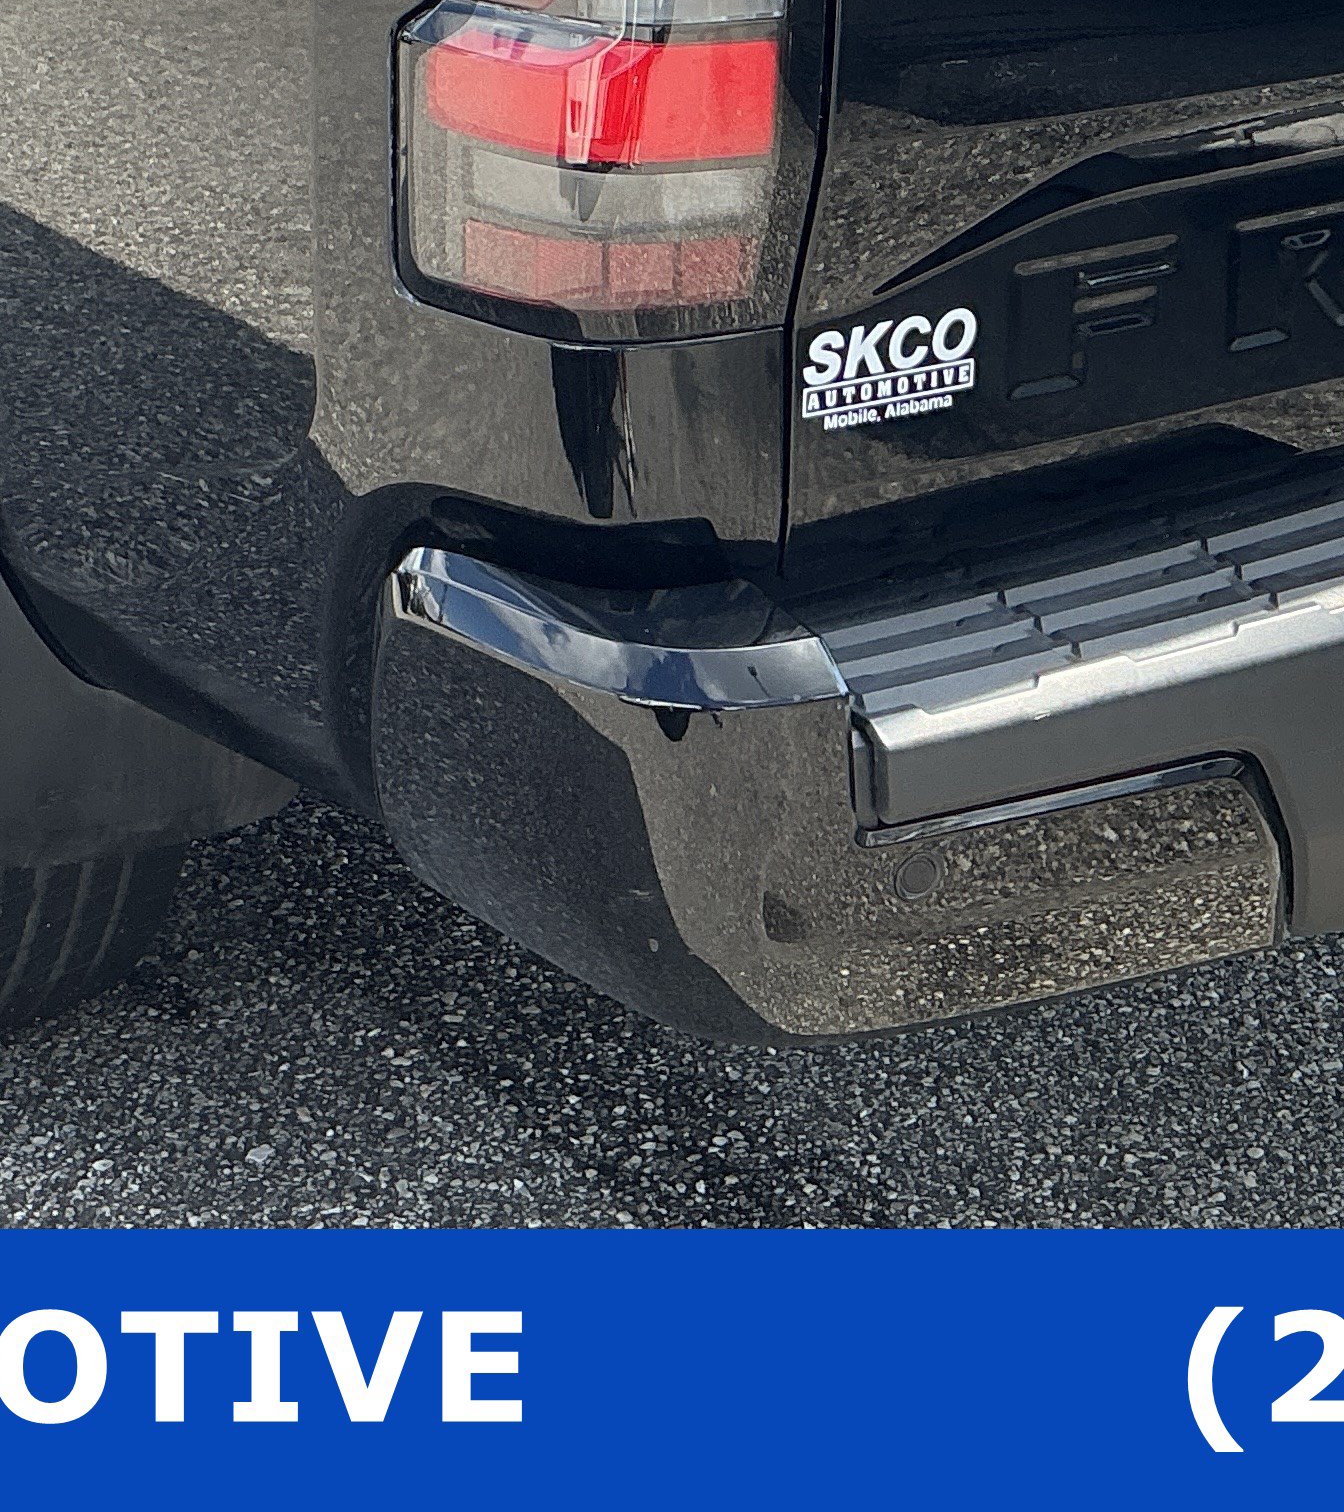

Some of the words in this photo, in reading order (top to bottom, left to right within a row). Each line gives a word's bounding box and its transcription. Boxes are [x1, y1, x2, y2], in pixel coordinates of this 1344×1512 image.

[802, 307, 978, 387] SKCO
[807, 365, 971, 411] AUTOMOTIVE
[884, 393, 953, 419] Alabama
